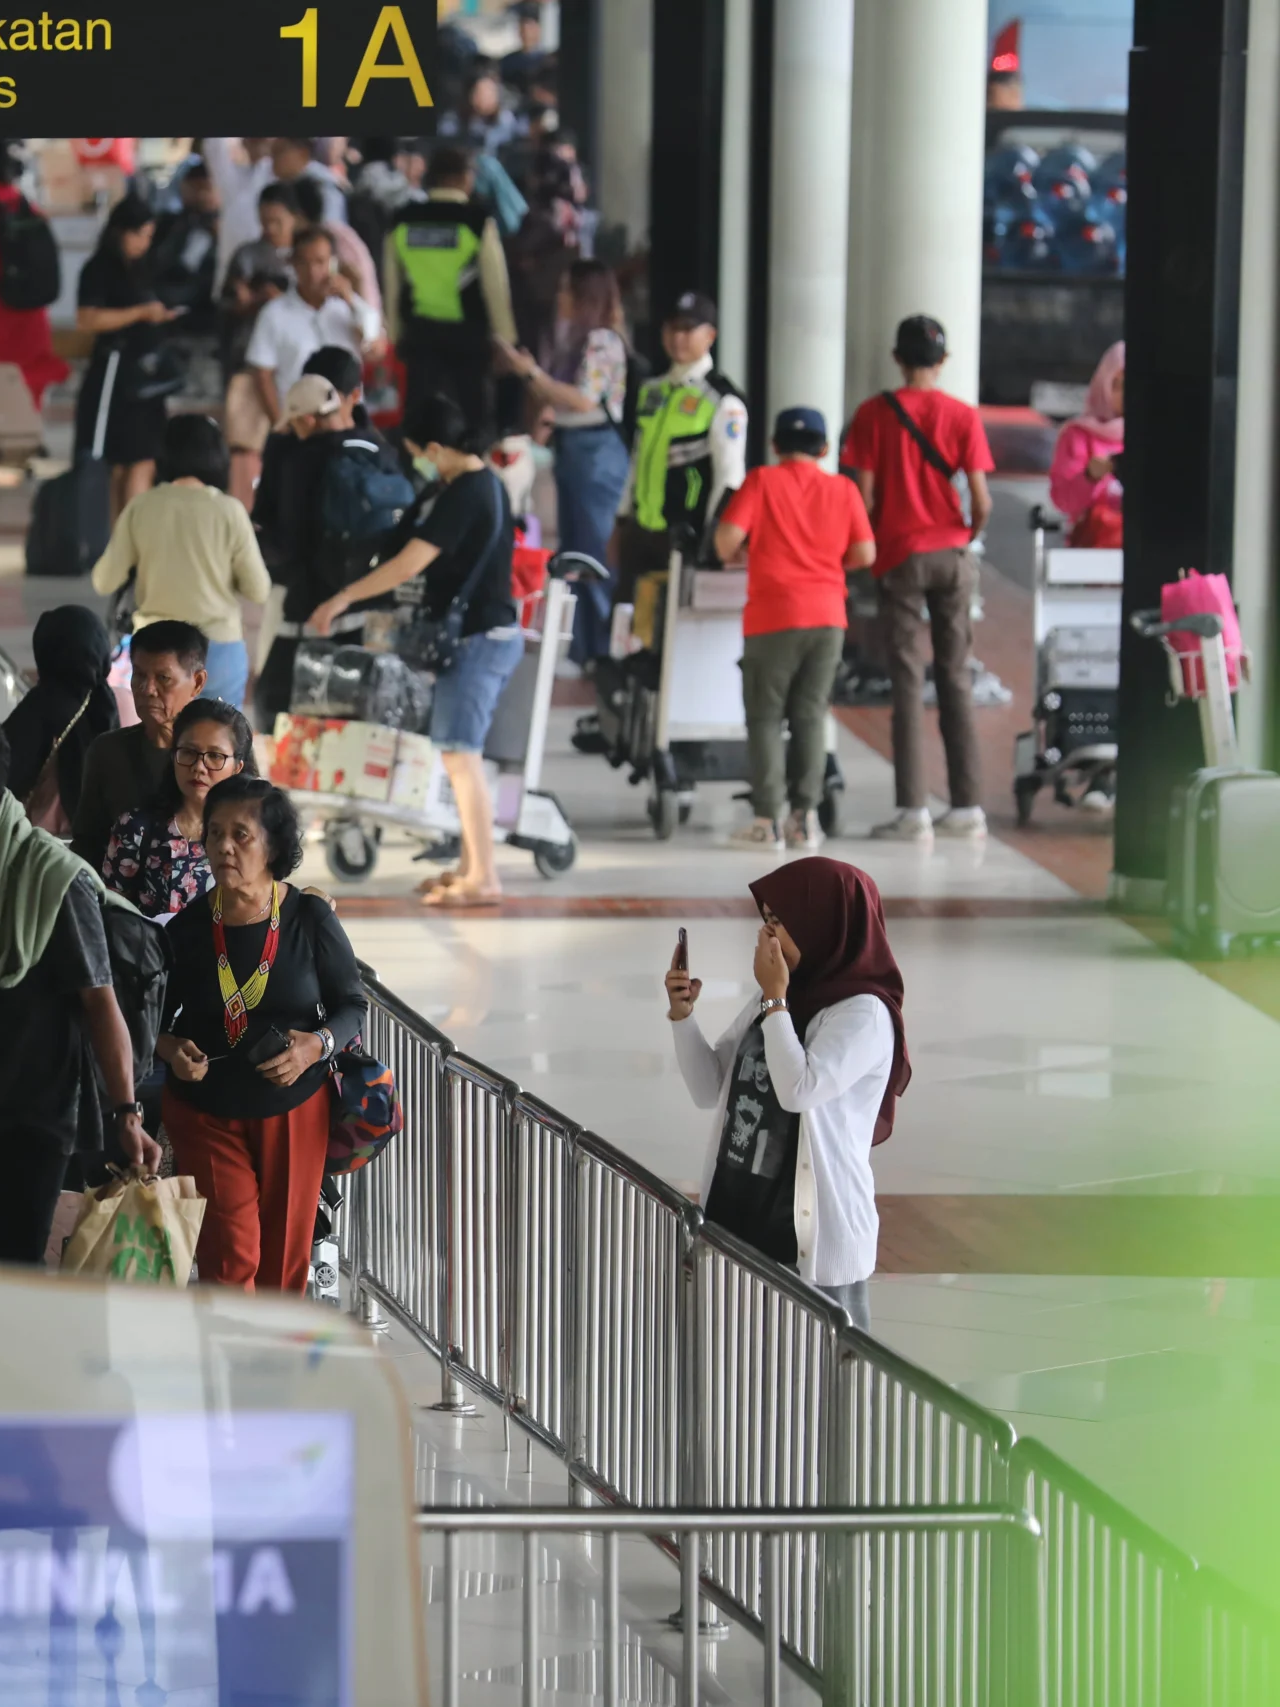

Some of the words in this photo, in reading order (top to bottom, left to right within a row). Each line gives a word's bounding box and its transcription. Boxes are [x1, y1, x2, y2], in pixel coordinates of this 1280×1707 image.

[279, 7, 319, 108] 1
[345, 5, 434, 108] A
[206, 1546, 297, 1616] 1A
